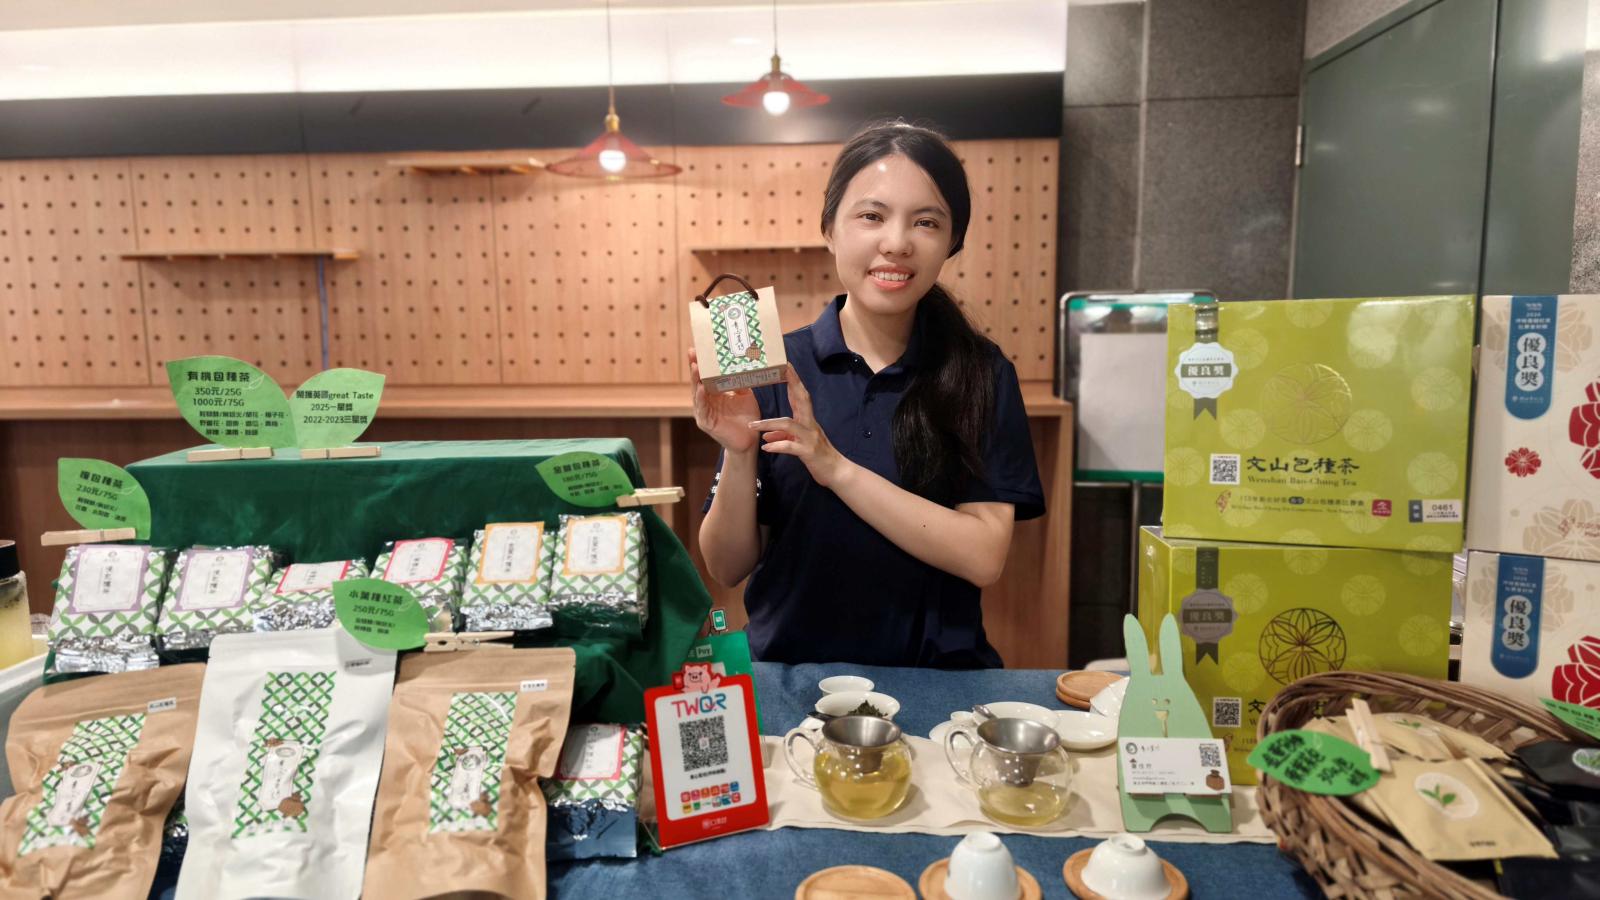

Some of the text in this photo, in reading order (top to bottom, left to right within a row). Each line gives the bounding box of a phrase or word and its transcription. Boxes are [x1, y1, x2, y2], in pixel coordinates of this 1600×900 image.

[1521, 337, 1541, 388] 優良獎
[187, 371, 250, 382] 有機包種茶
[1188, 365, 1225, 377] 優良獎
[194, 387, 242, 396] 350元/25G
[352, 391, 374, 399] Taste
[192, 397, 245, 407] 1000元/75G
[311, 402, 353, 411] 2025一星獎
[303, 415, 368, 424] 2022-2023三星獎
[1246, 456, 1360, 475] 文山包種茶
[1508, 599, 1528, 648] 優良獎
[672, 693, 727, 718] TWQR
